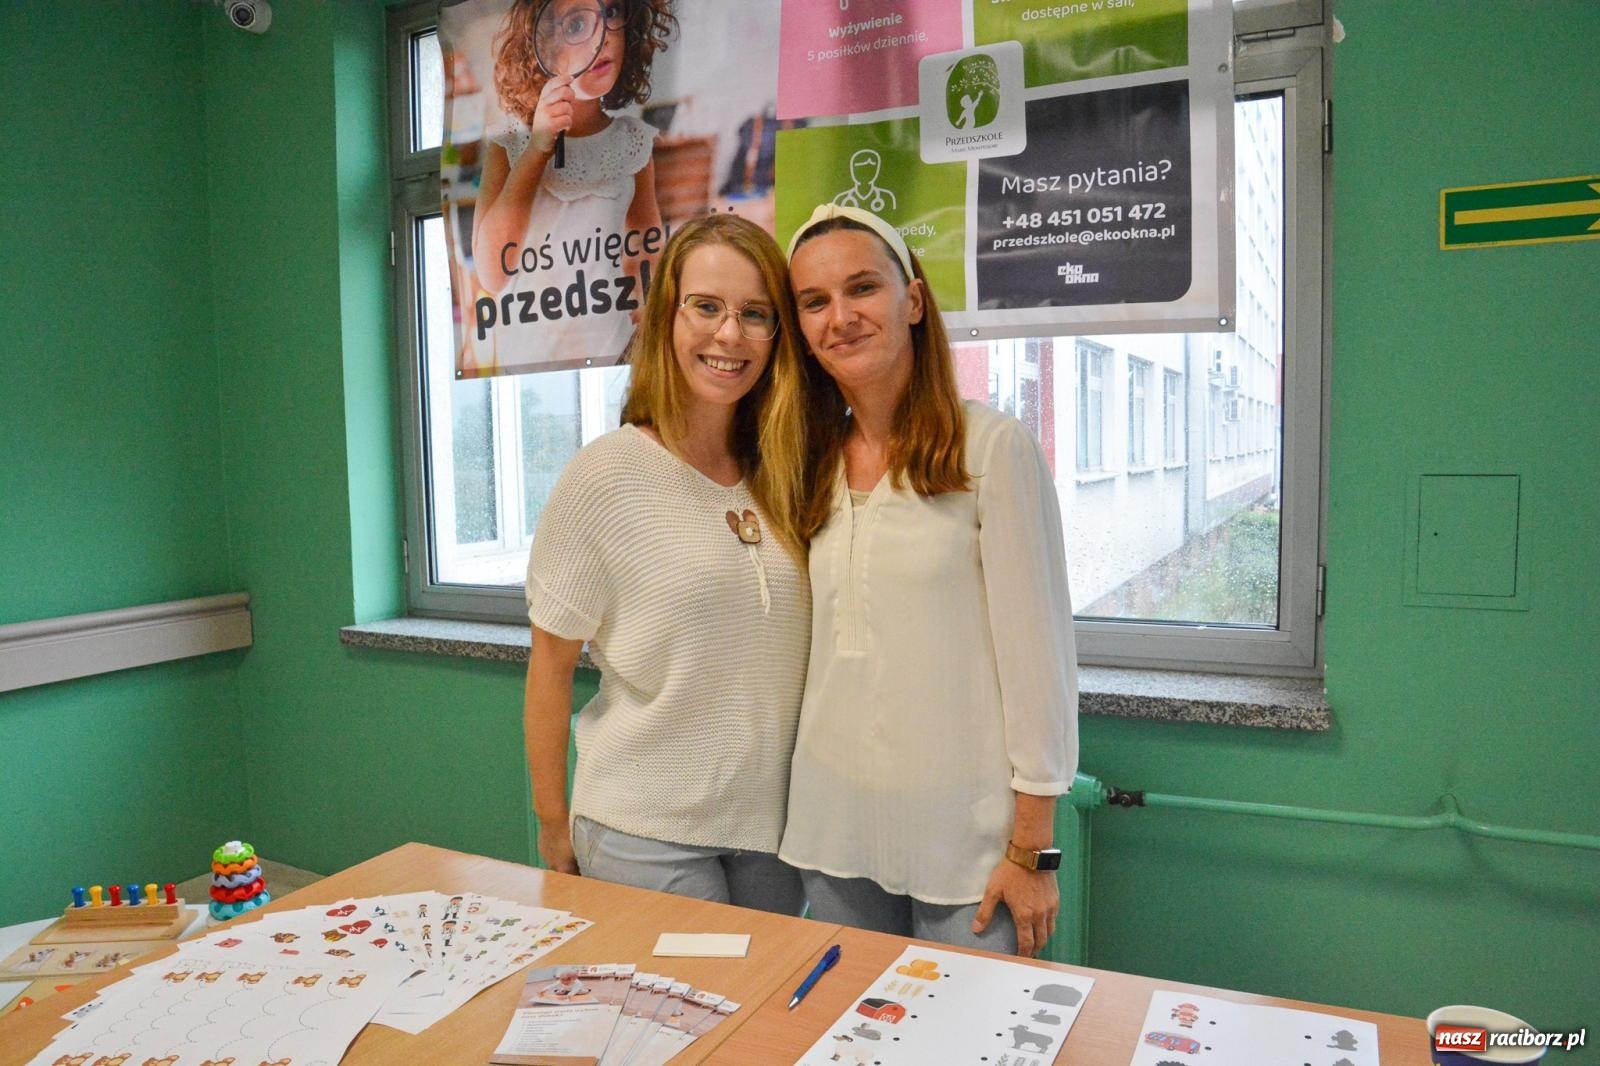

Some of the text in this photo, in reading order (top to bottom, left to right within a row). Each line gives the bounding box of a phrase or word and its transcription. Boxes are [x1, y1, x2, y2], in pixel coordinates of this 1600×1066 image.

[1021, 3, 1088, 22] dostępne
[1091, 1, 1105, 11] w
[828, 12, 904, 39] Wyżywienie
[807, 50, 817, 61] 5
[817, 41, 871, 63] posiłków
[1001, 159, 1173, 196] Masz pytania?
[1002, 202, 1167, 230] +48 451 051 472
[992, 224, 1176, 251] przedszkole@ekookna.pl
[500, 233, 554, 277] Coś
